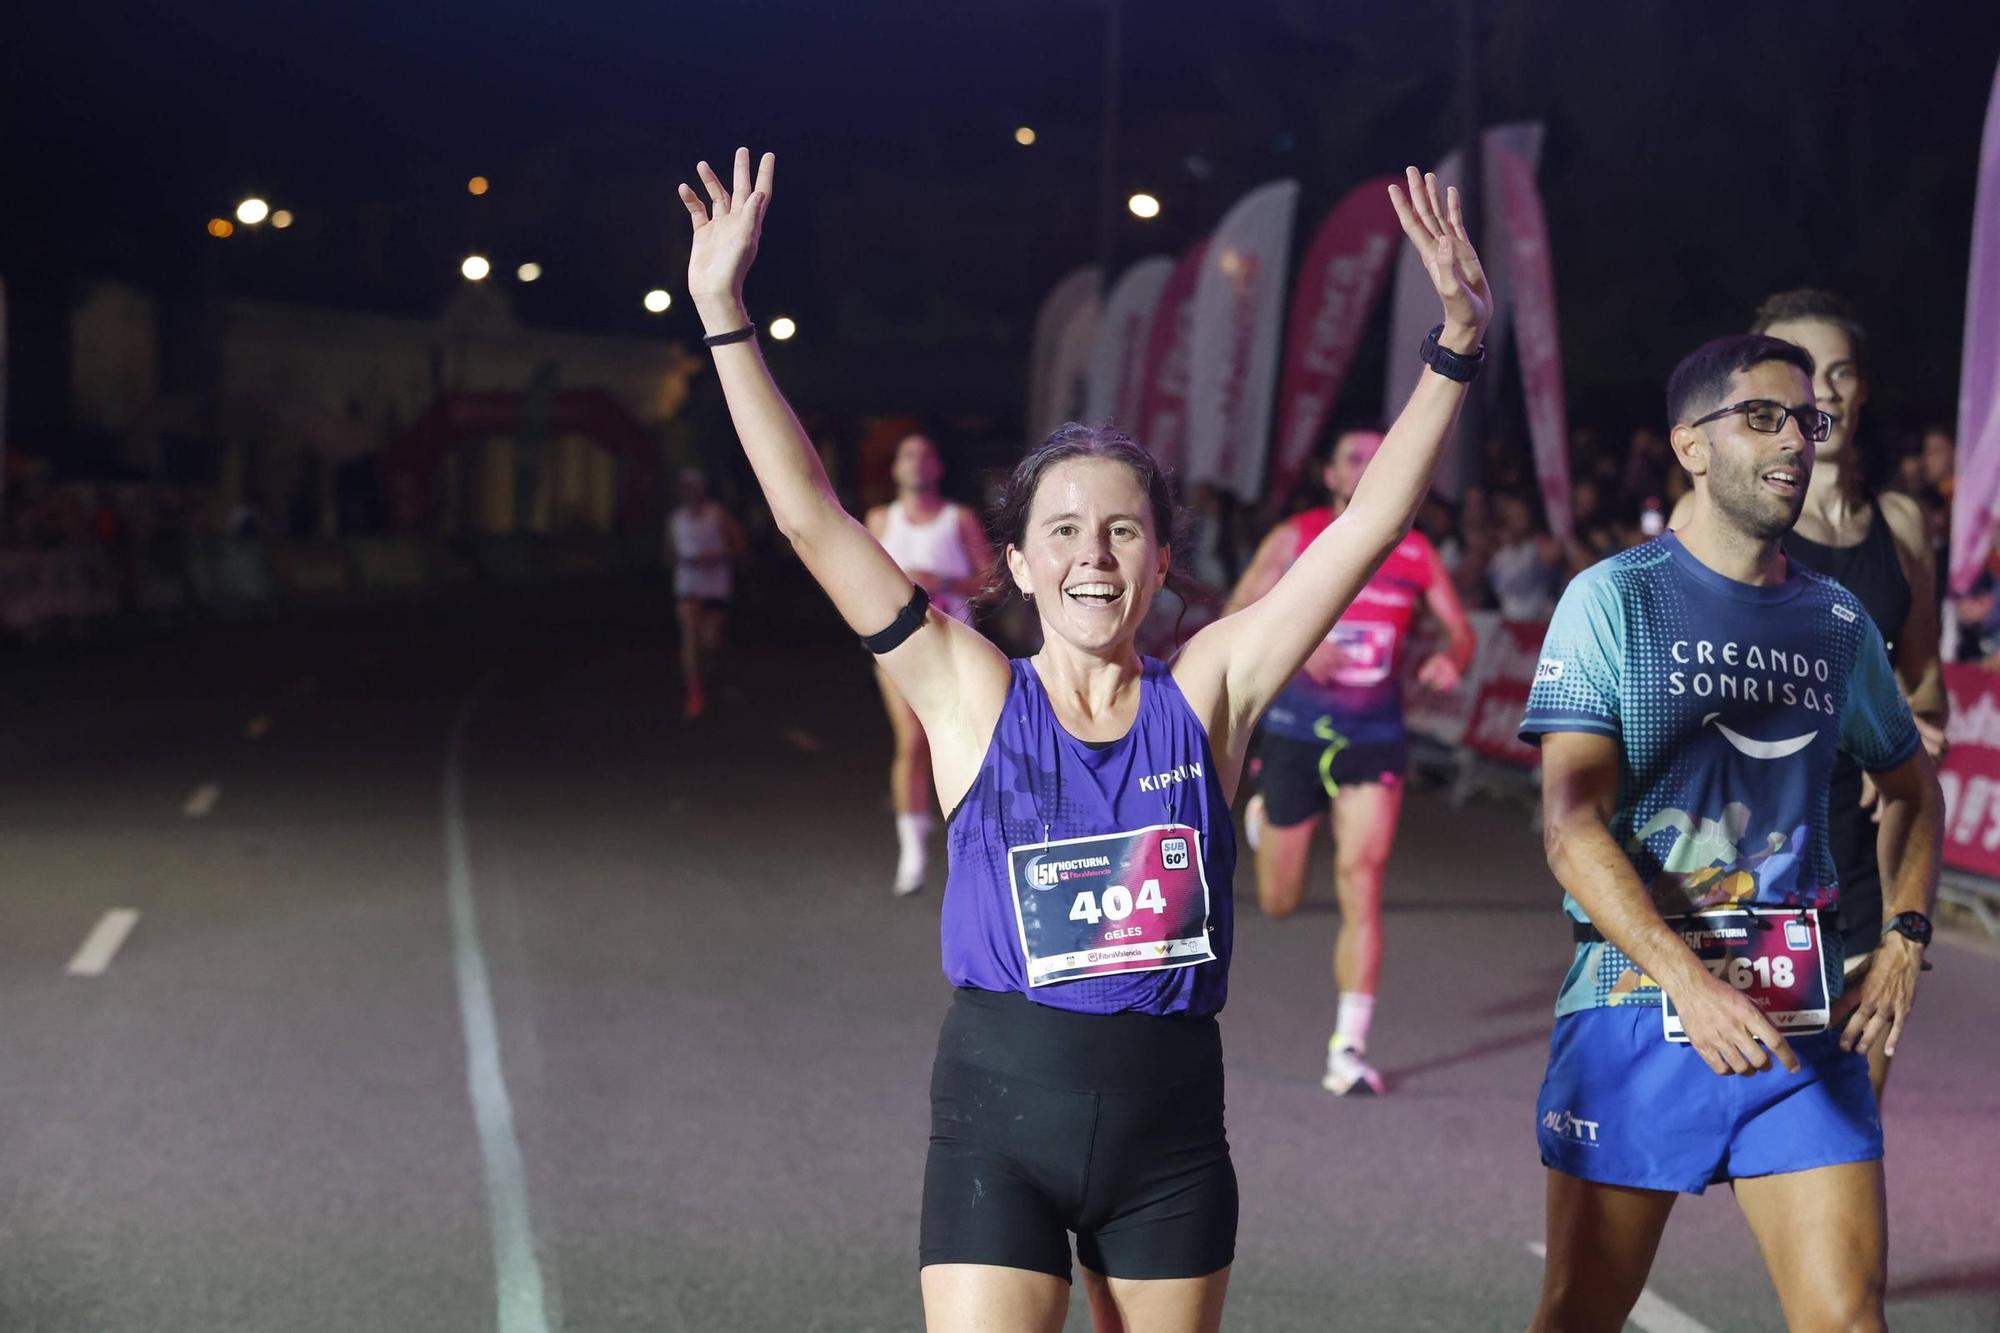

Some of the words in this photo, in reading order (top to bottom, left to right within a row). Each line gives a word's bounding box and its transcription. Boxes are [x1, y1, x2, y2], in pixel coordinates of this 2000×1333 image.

[1671, 640, 1829, 682] CREANDO
[1669, 671, 1835, 715] SONRISAS
[1139, 762, 1203, 792] KIPRUN
[1164, 842, 1185, 852] SUB
[1033, 861, 1059, 886] 15K
[1058, 855, 1110, 871] NOCTURNA
[1069, 879, 1167, 925] 404
[1104, 926, 1143, 941] GELES
[1098, 949, 1142, 961] FibraValencia
[1703, 955, 1796, 990] 7618
